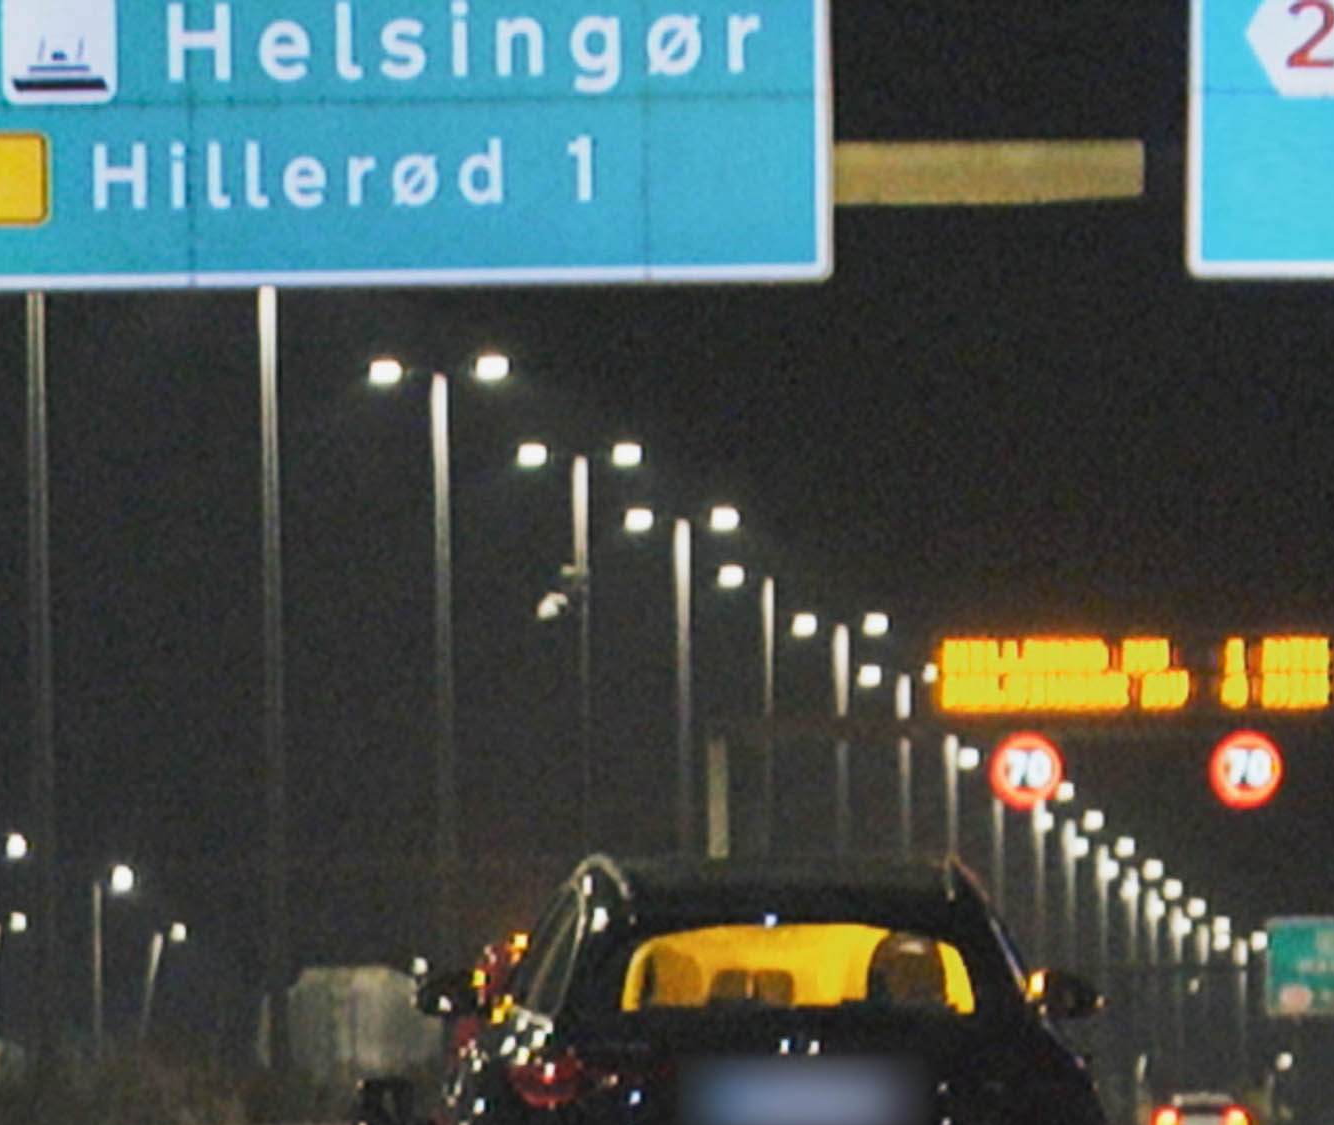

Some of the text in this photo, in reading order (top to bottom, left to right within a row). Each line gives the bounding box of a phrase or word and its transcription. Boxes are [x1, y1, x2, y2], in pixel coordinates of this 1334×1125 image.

[168, 0, 761, 94] Helsingør
[92, 134, 594, 211] Hillerød 1
[1005, 748, 1053, 789] 70
[1225, 748, 1273, 789] 70
